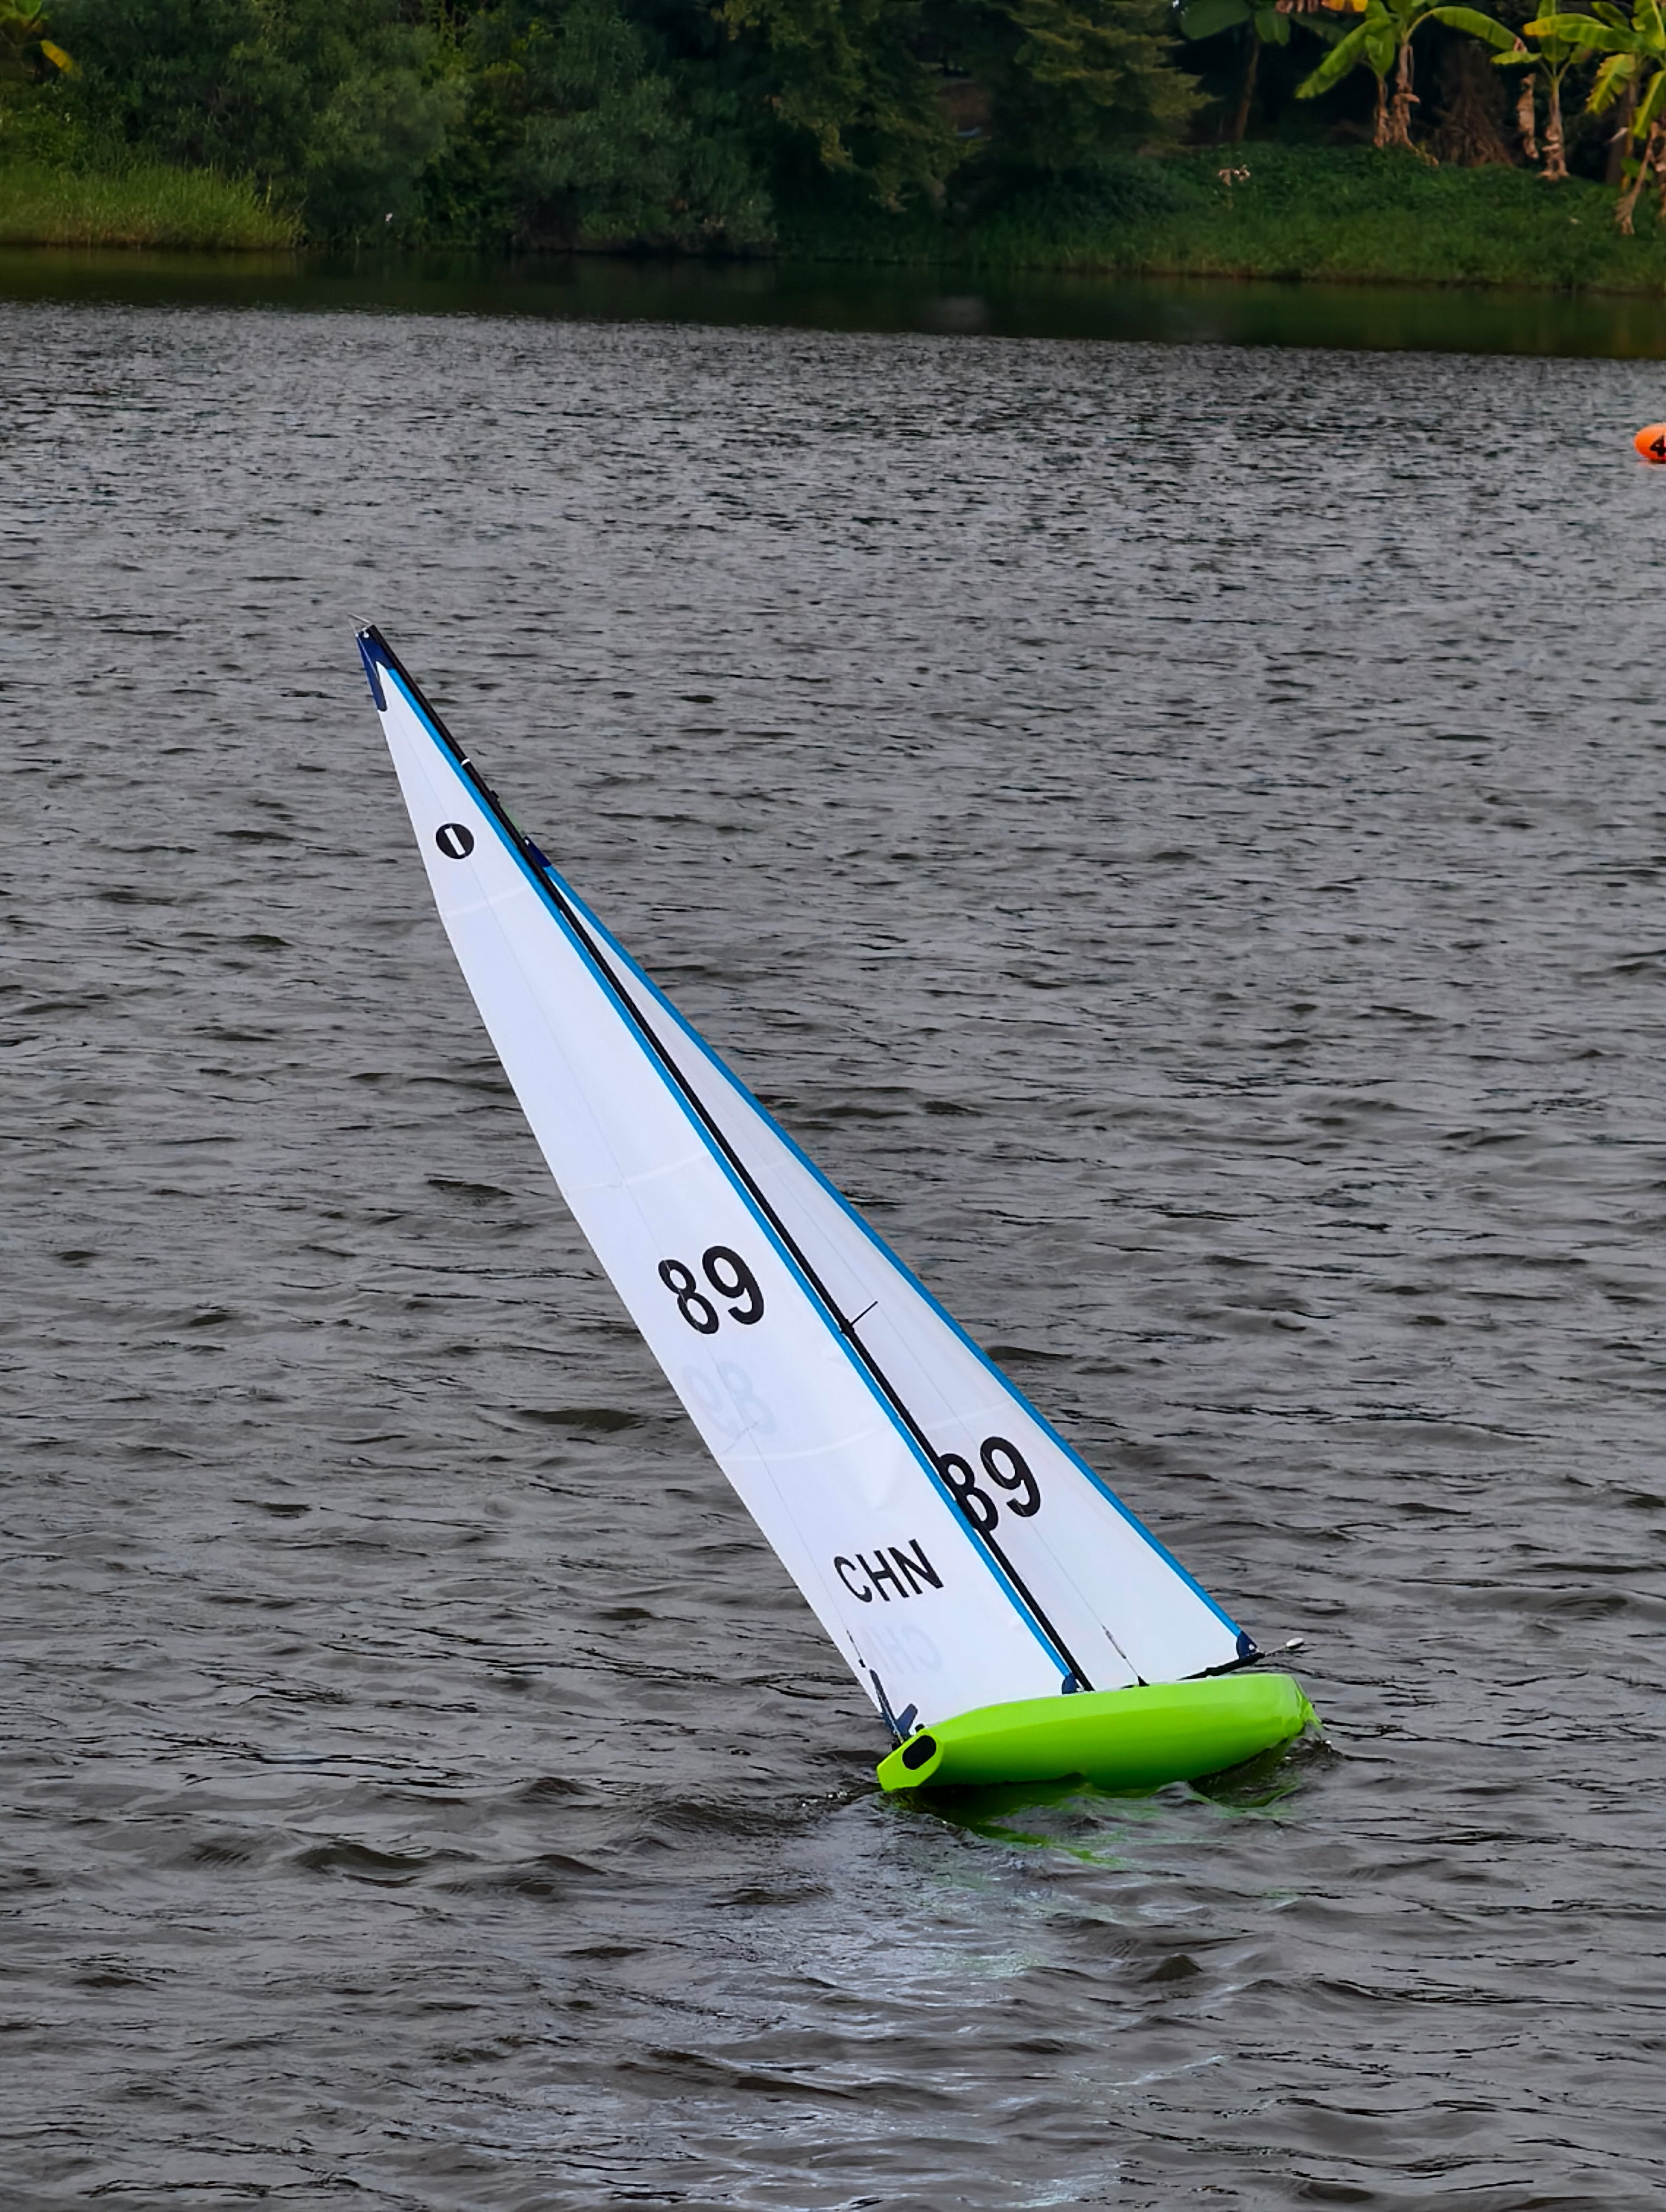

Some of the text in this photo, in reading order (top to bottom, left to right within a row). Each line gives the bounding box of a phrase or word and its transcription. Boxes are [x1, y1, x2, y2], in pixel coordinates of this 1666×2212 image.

[1650, 435, 1666, 457] 4
[658, 1245, 764, 1334] 89
[938, 1437, 1041, 1532] 89
[834, 1539, 944, 1603] CHN
